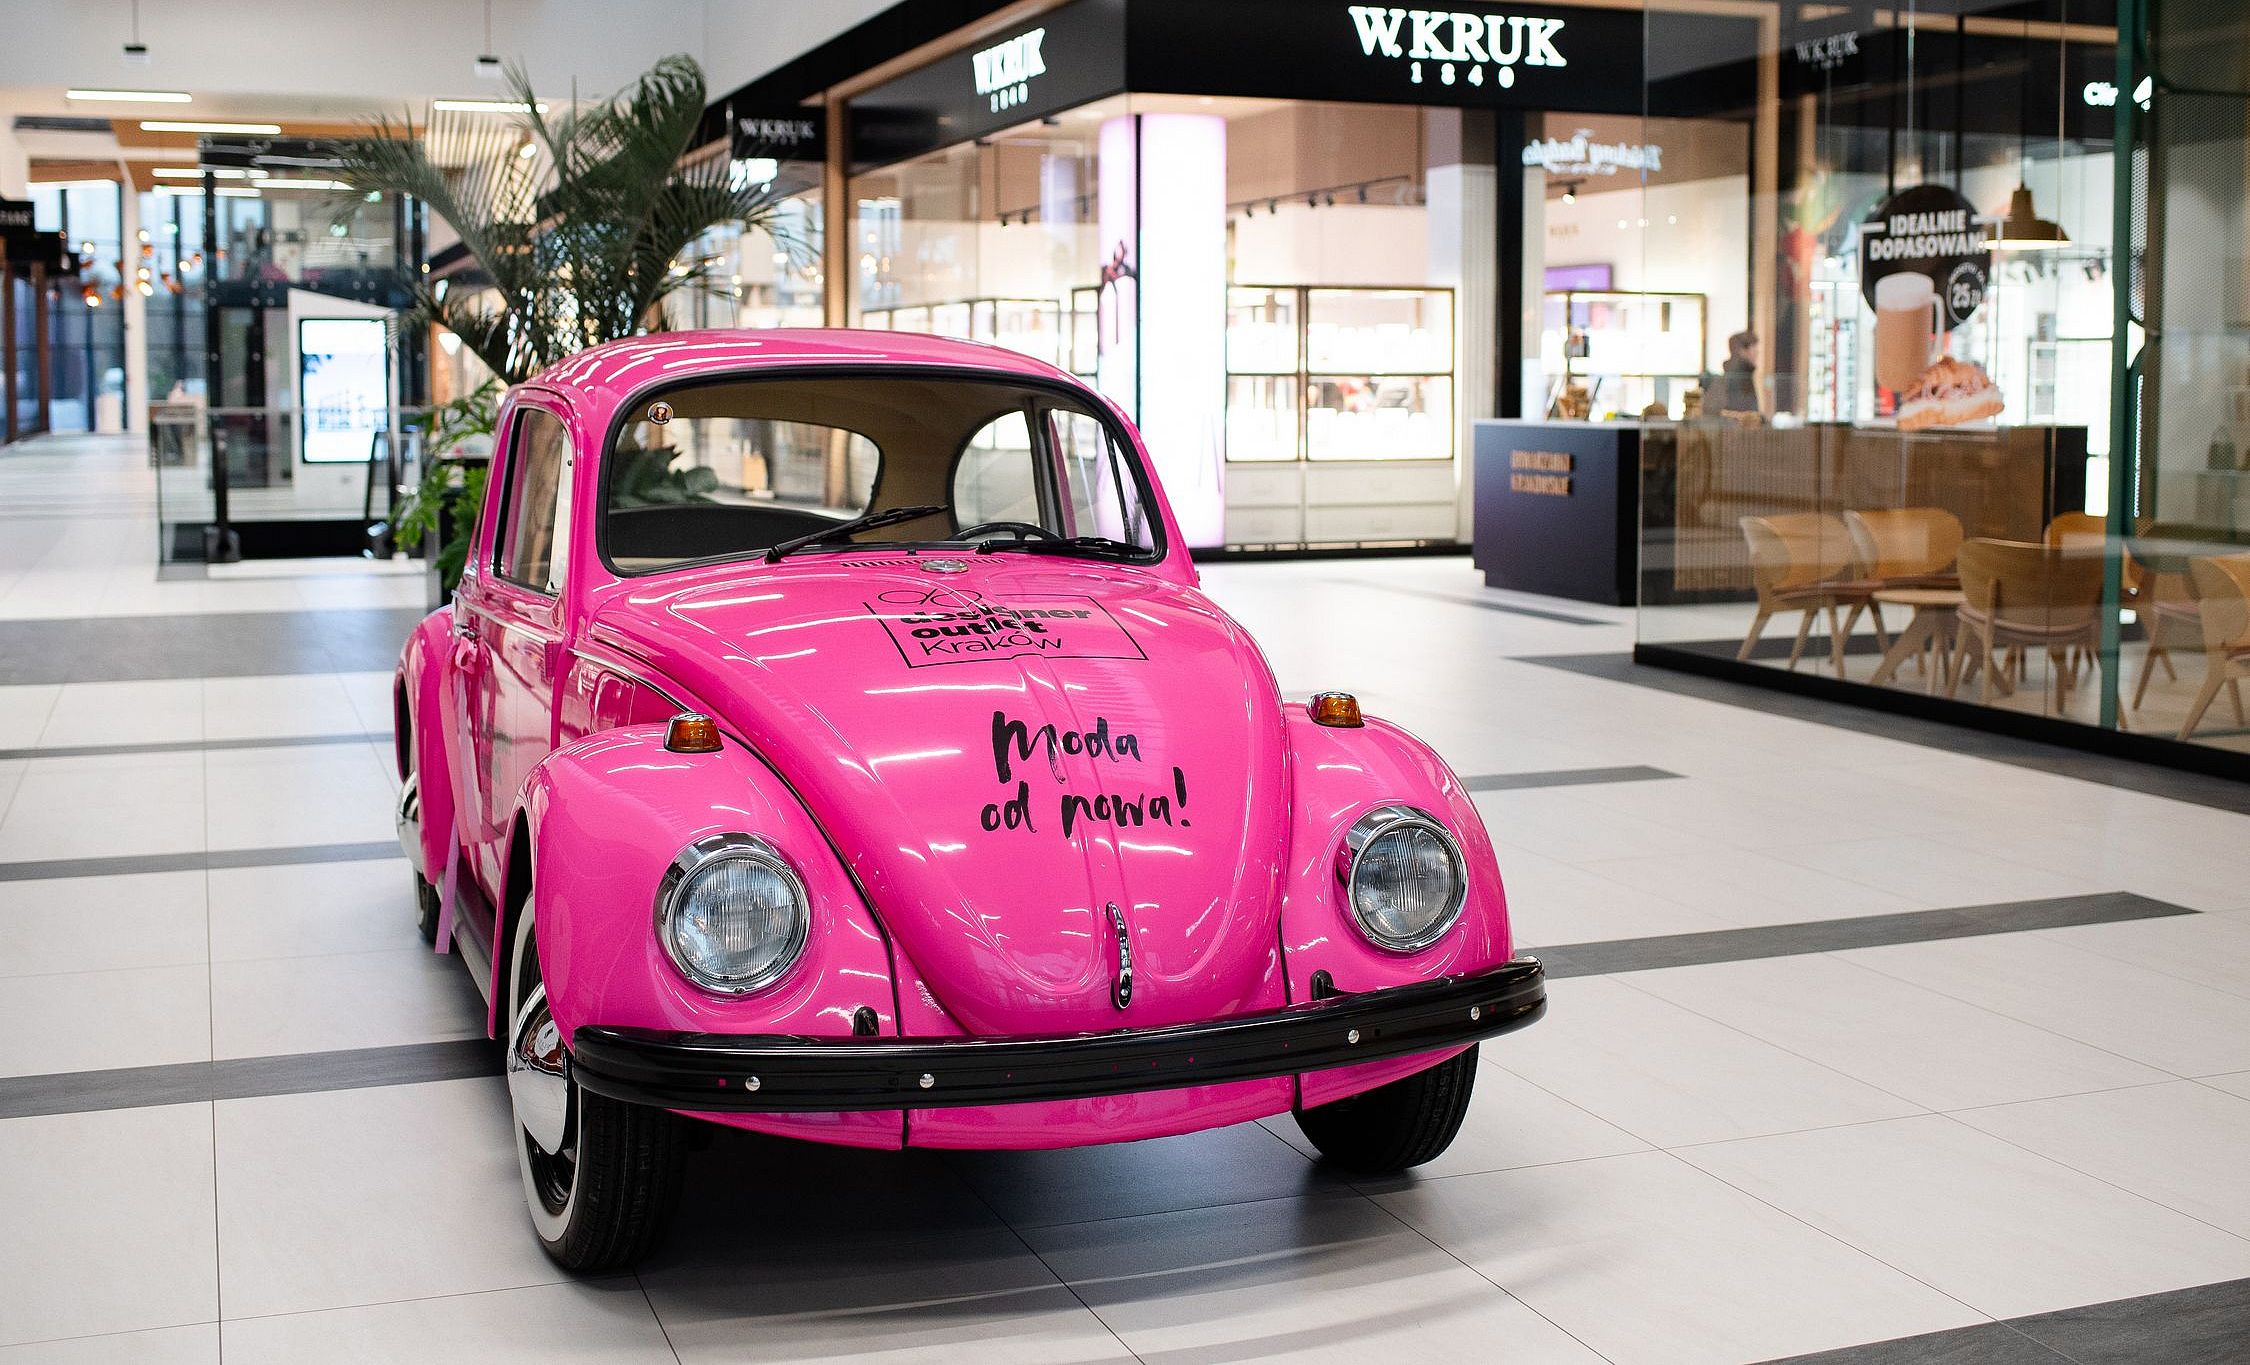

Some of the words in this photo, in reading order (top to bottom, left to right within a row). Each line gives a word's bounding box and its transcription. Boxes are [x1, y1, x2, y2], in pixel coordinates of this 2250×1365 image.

[1410, 61, 1515, 89] 1840
[1889, 209, 1967, 236] IDEALNIE
[900, 604, 1093, 624] designer
[911, 616, 1048, 639] outlet
[919, 631, 1061, 656] Kraków
[992, 711, 1142, 784] Moda
[981, 781, 1037, 833] od
[1061, 766, 1191, 840] nowa!
